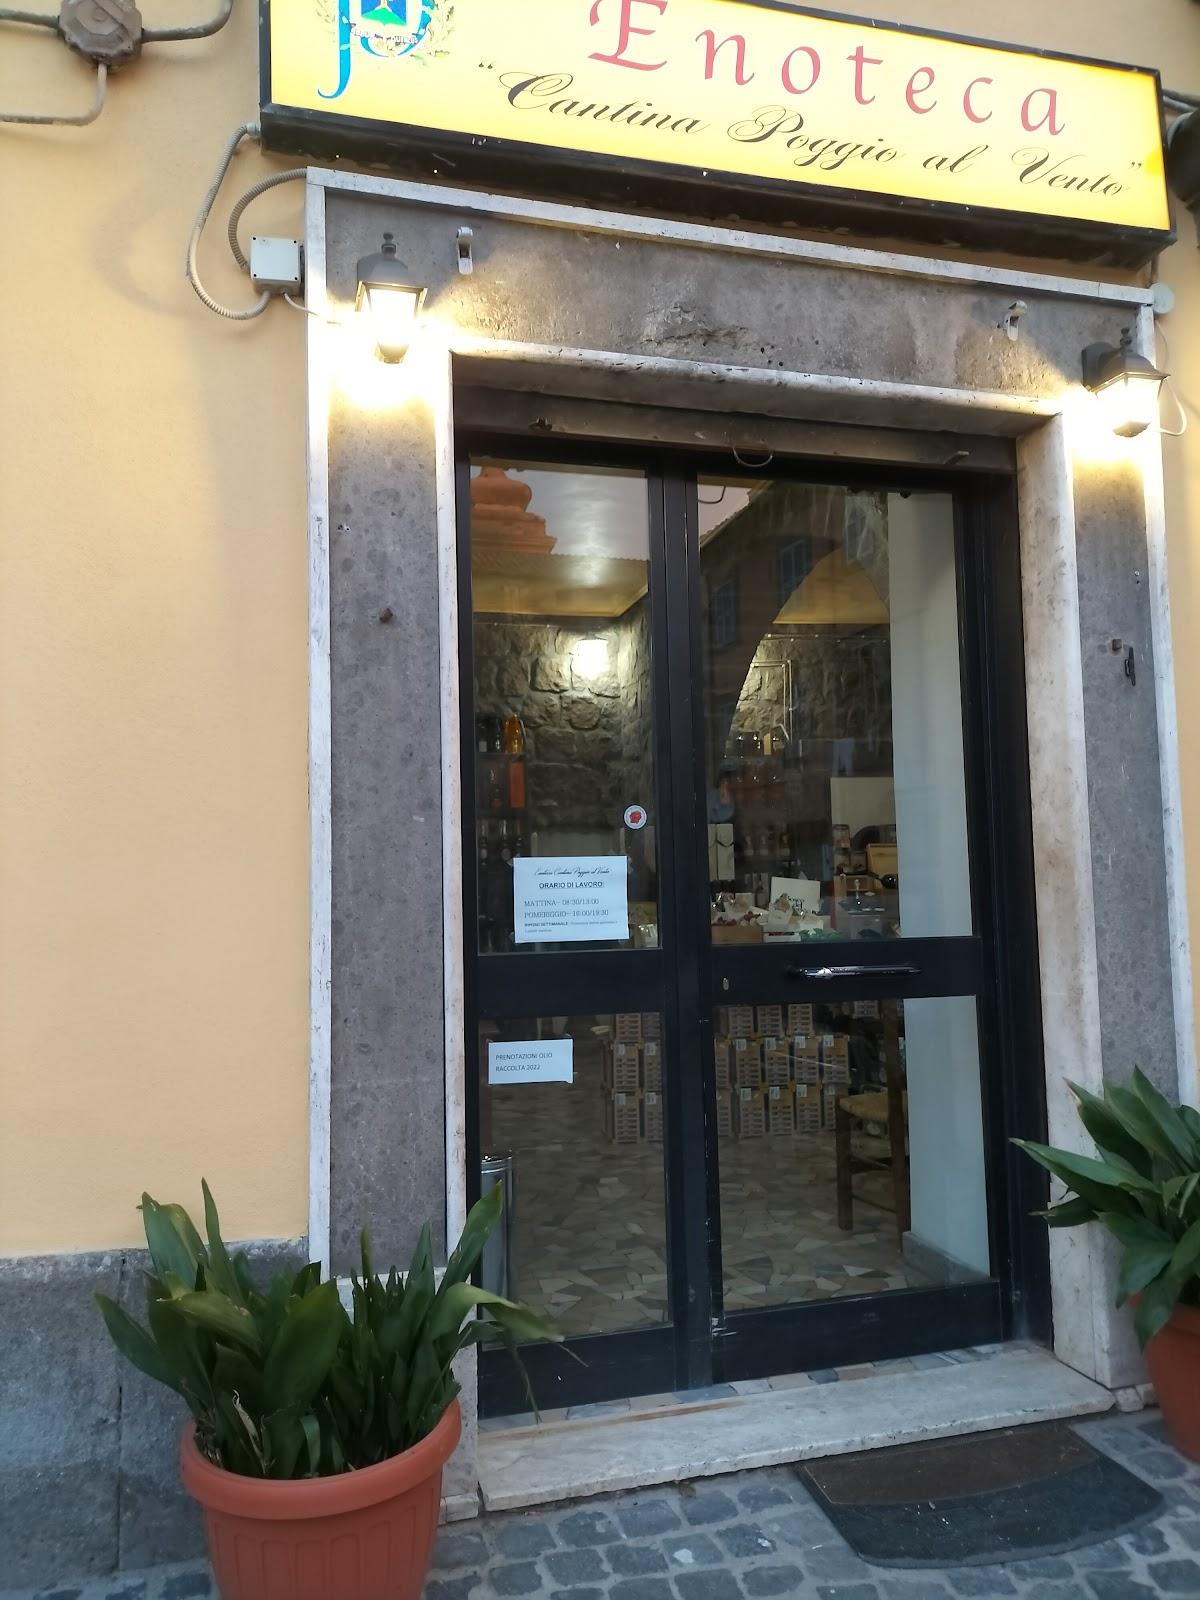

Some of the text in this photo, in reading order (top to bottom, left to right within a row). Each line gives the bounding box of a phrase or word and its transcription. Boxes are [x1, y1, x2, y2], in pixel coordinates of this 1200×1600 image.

[588, 0, 1066, 136] Enoteca
[727, 104, 902, 171] Poggio
[922, 144, 989, 175] al
